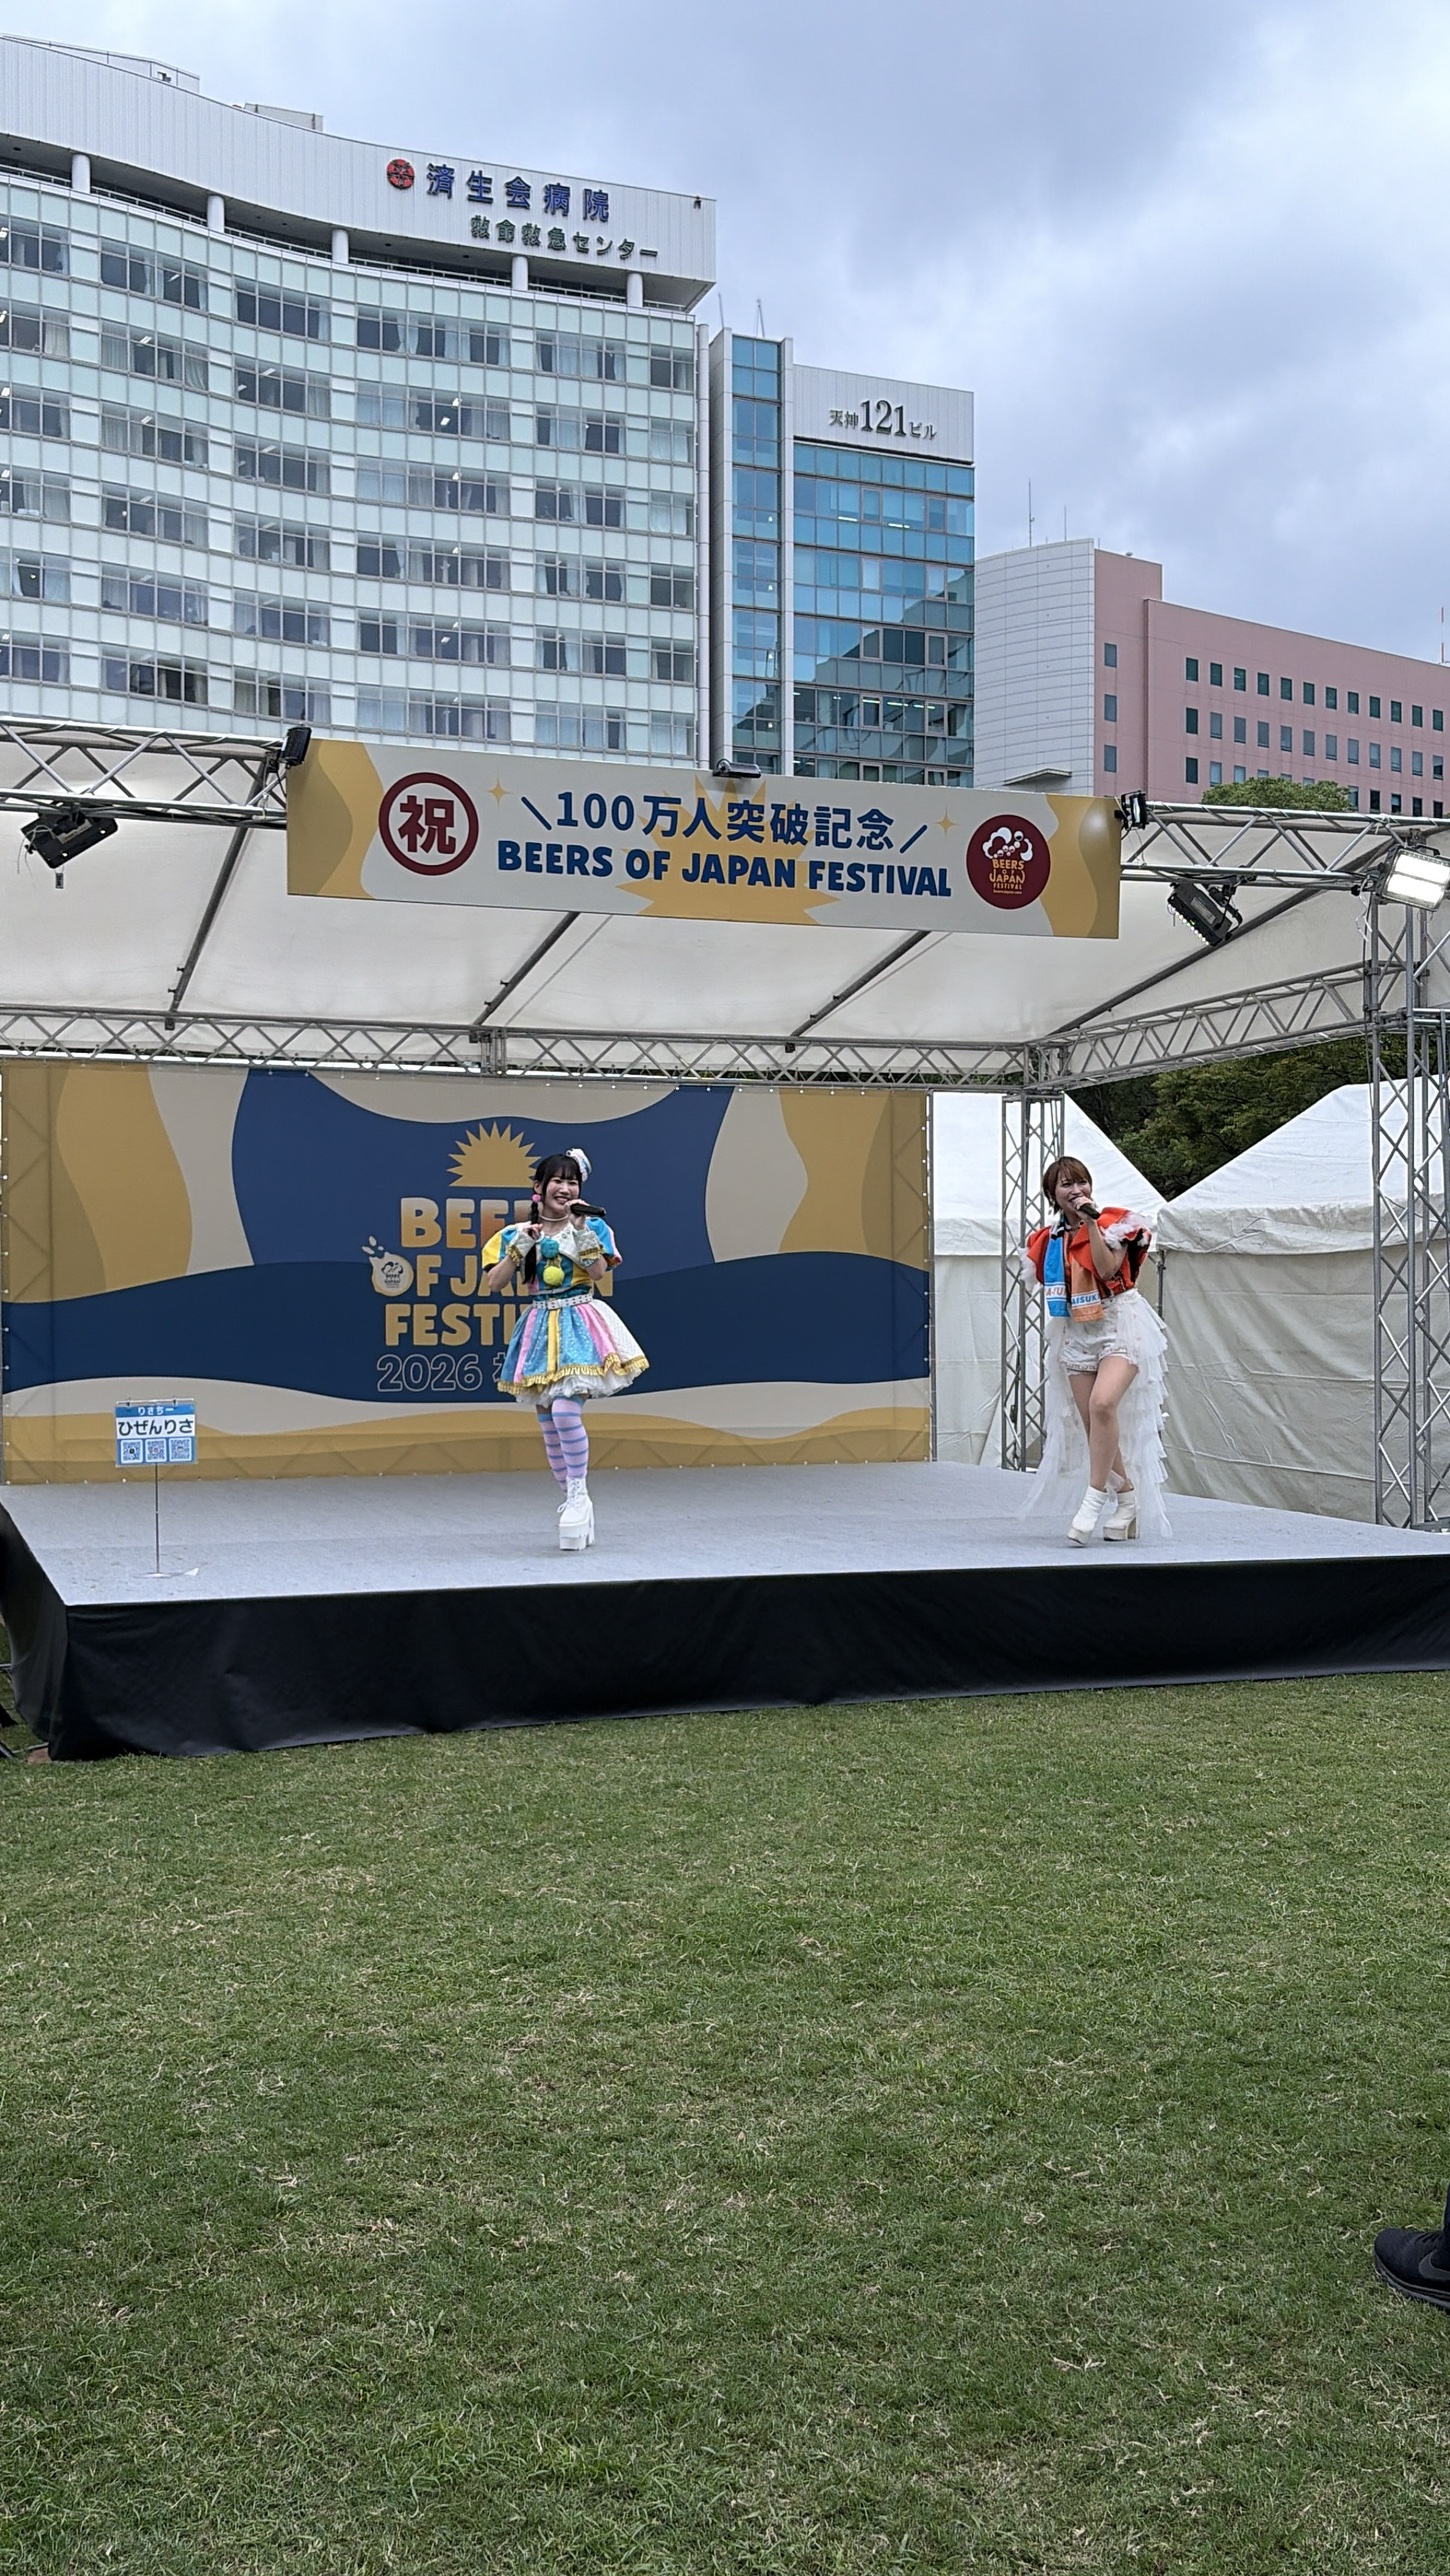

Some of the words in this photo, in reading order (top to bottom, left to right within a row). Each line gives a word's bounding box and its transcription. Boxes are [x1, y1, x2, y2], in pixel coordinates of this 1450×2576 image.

[426, 162, 610, 222] 済生会病院
[470, 214, 659, 260] 救命救急センター
[828, 399, 937, 440] 天神121ビル
[397, 795, 457, 854] 祝
[556, 791, 894, 851] 100万人突破記念
[497, 840, 613, 878] BEERS
[625, 848, 671, 879] OF
[681, 852, 796, 889] JAPAN
[808, 859, 952, 897] FESTIVAL
[989, 868, 1025, 884] JAPAN
[992, 858, 1025, 870] BEERS
[376, 1353, 483, 1392] 2026
[118, 1418, 194, 1436] ひぜんりさ
